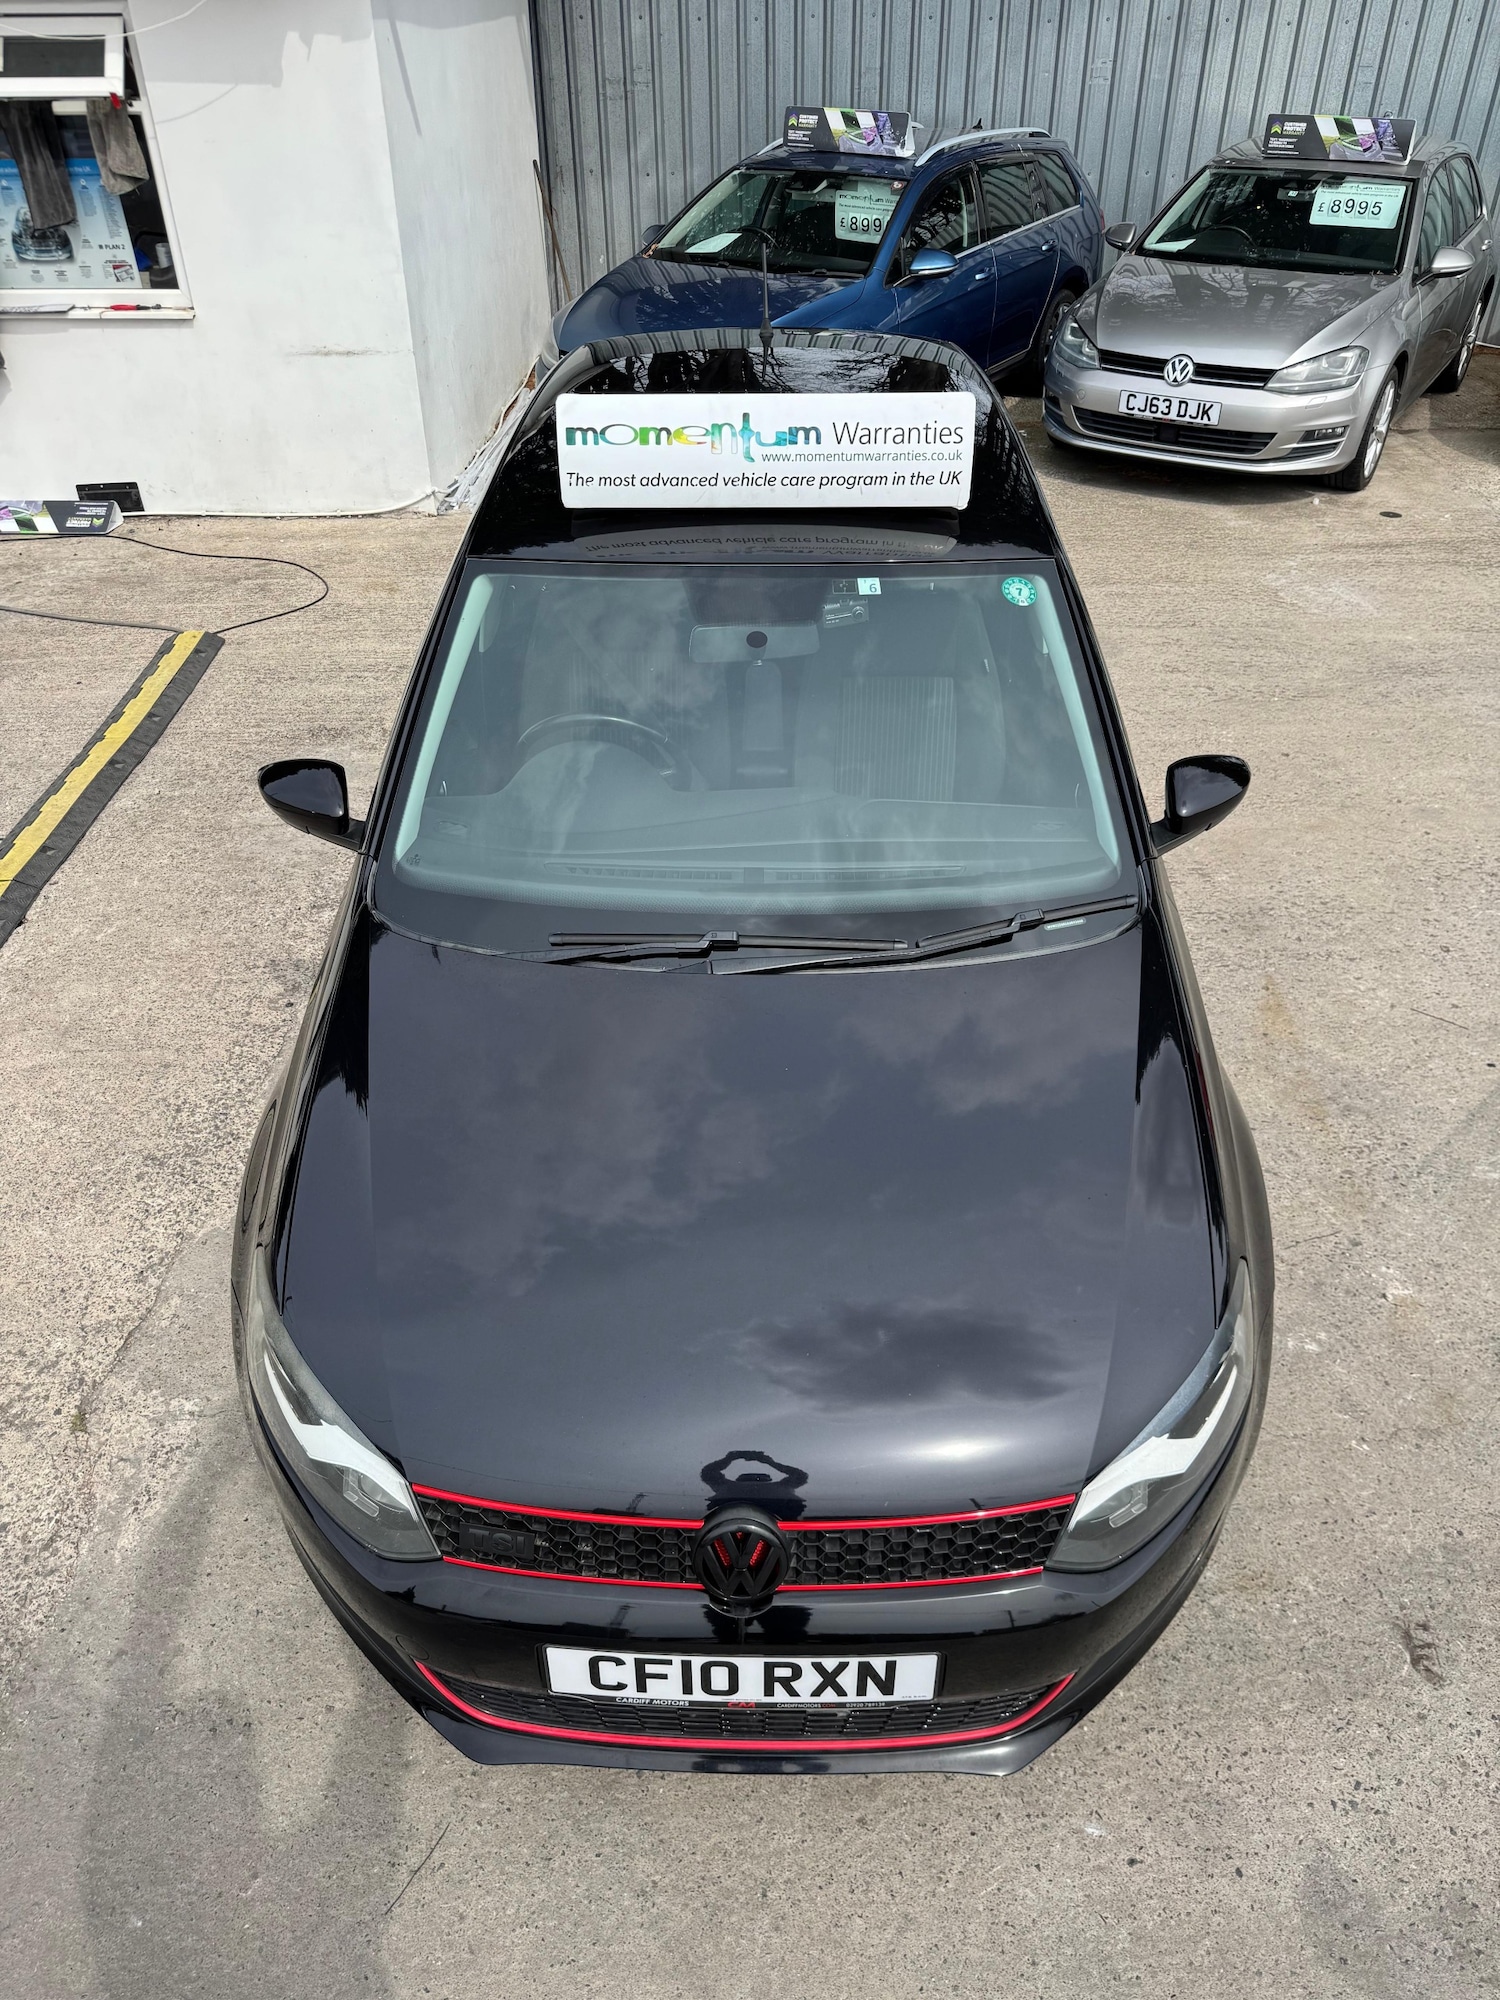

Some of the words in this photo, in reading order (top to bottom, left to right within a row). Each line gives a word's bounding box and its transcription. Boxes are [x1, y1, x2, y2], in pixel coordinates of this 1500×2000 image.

[840, 216, 882, 232] £899
[1126, 393, 1171, 416] CJ63
[1176, 400, 1213, 422] DJK
[565, 412, 822, 463] momentum
[832, 420, 964, 445] Warranties
[761, 450, 963, 462] www.momentumwarranties.co.uk
[566, 472, 594, 487] The
[598, 473, 636, 487] most
[642, 472, 719, 487] advanced
[722, 472, 777, 487] vehicle
[780, 474, 817, 487] care
[818, 474, 888, 490] program
[891, 471, 906, 486] in
[910, 471, 935, 486] the
[939, 470, 963, 485] UK
[589, 1655, 740, 1696] CF10
[763, 1659, 898, 1697] RXN
[615, 1697, 651, 1705] CARDIFF
[652, 1699, 690, 1707] MOTORS
